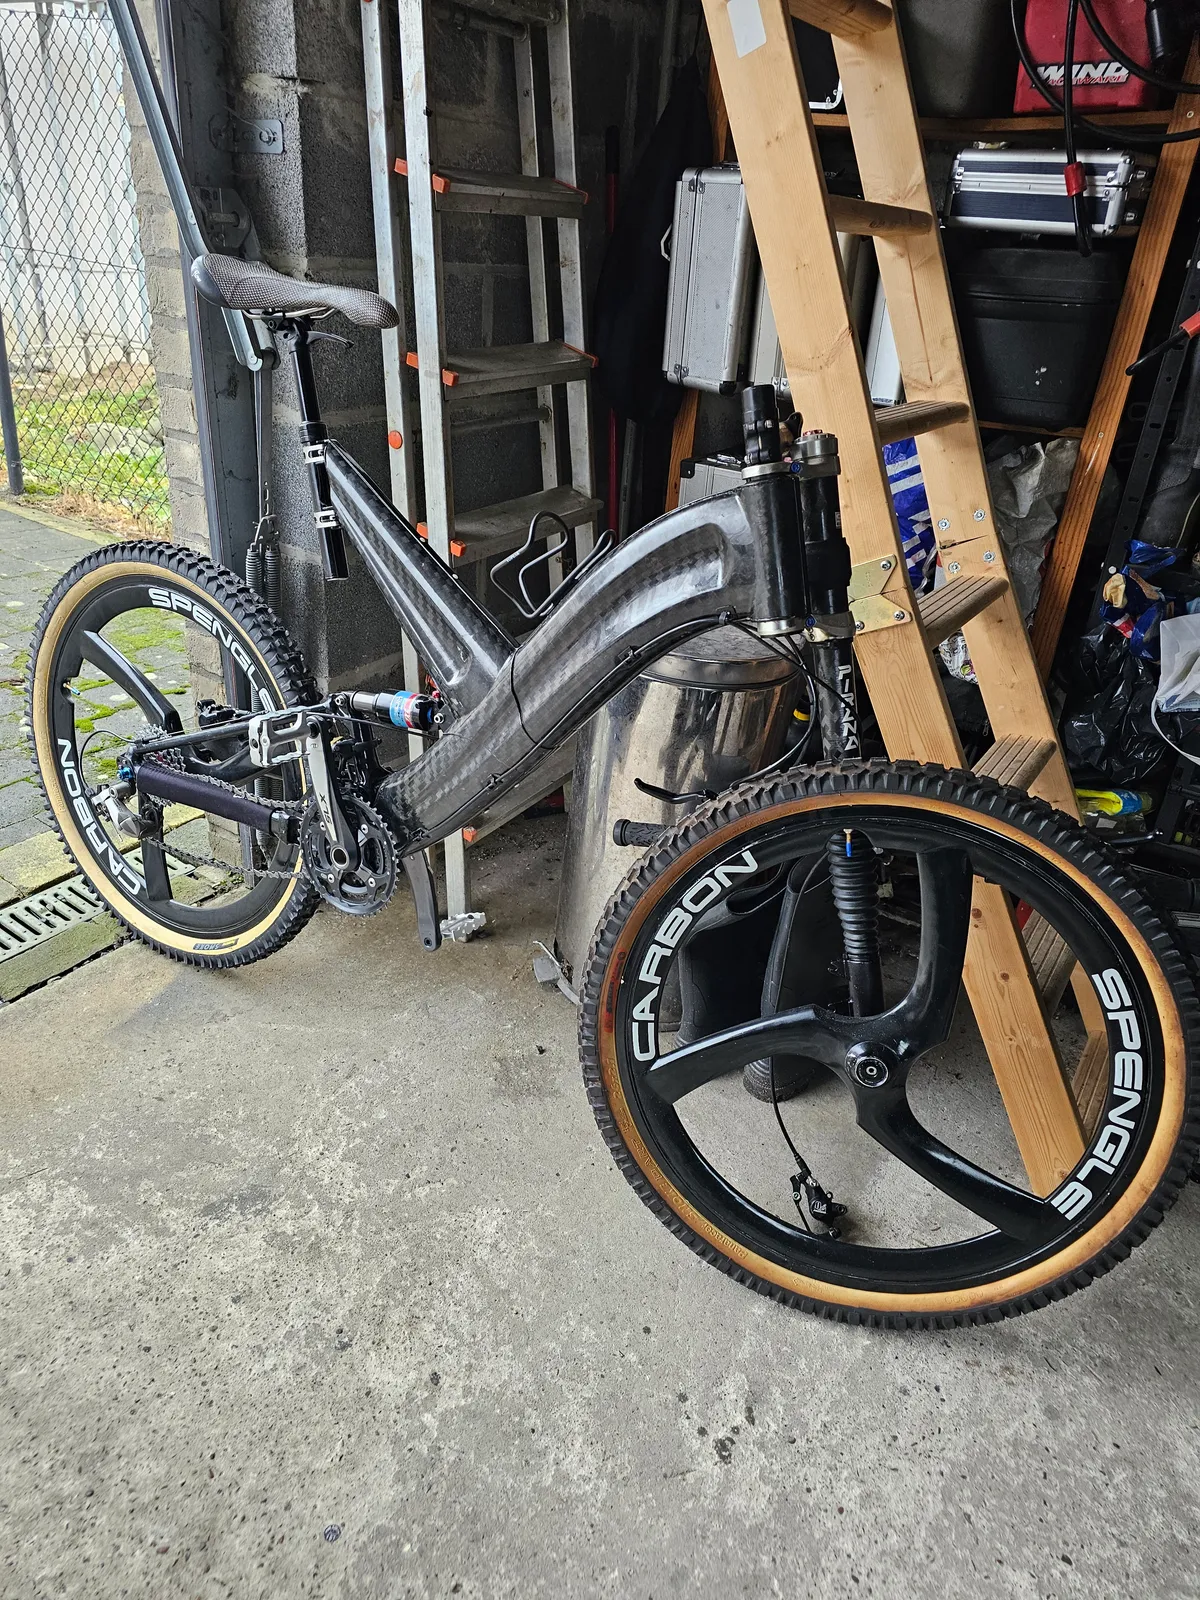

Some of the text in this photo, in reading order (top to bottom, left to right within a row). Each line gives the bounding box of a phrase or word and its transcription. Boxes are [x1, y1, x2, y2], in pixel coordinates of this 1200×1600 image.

[1036, 61, 1129, 82] WIND
[148, 587, 277, 712] SPENGLE
[57, 738, 141, 896] CARBON
[632, 850, 758, 1061] CARBON
[1050, 968, 1144, 1221] SPENGLE
